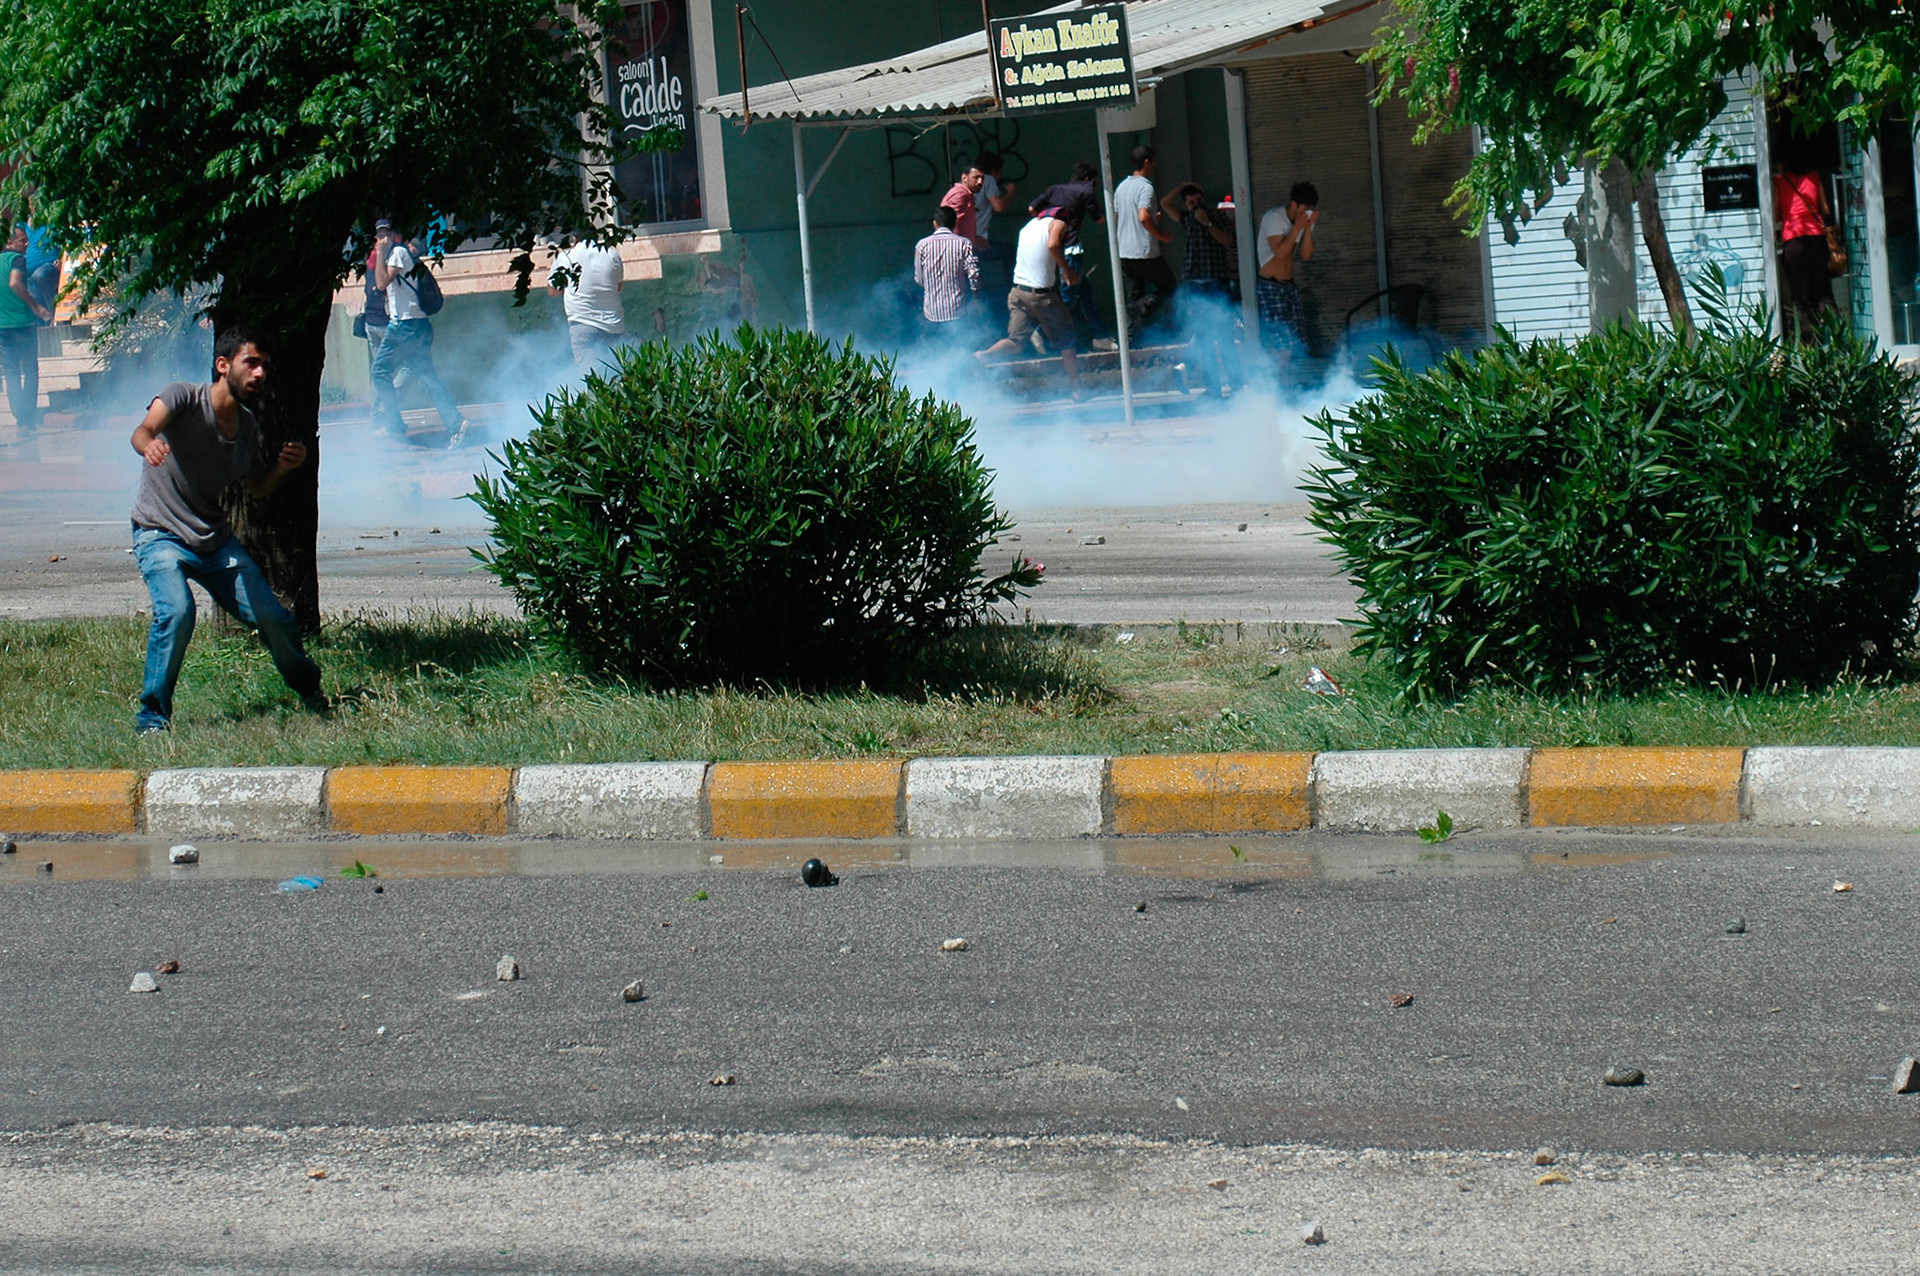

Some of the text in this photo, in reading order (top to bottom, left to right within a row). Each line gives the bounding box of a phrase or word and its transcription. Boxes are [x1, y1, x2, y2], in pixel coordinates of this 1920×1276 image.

[1000, 13, 1119, 62] Aykan Kuaför
[618, 61, 649, 82] saloon
[620, 56, 682, 119] cadde
[1004, 58, 1125, 86] & Ağda Salonu
